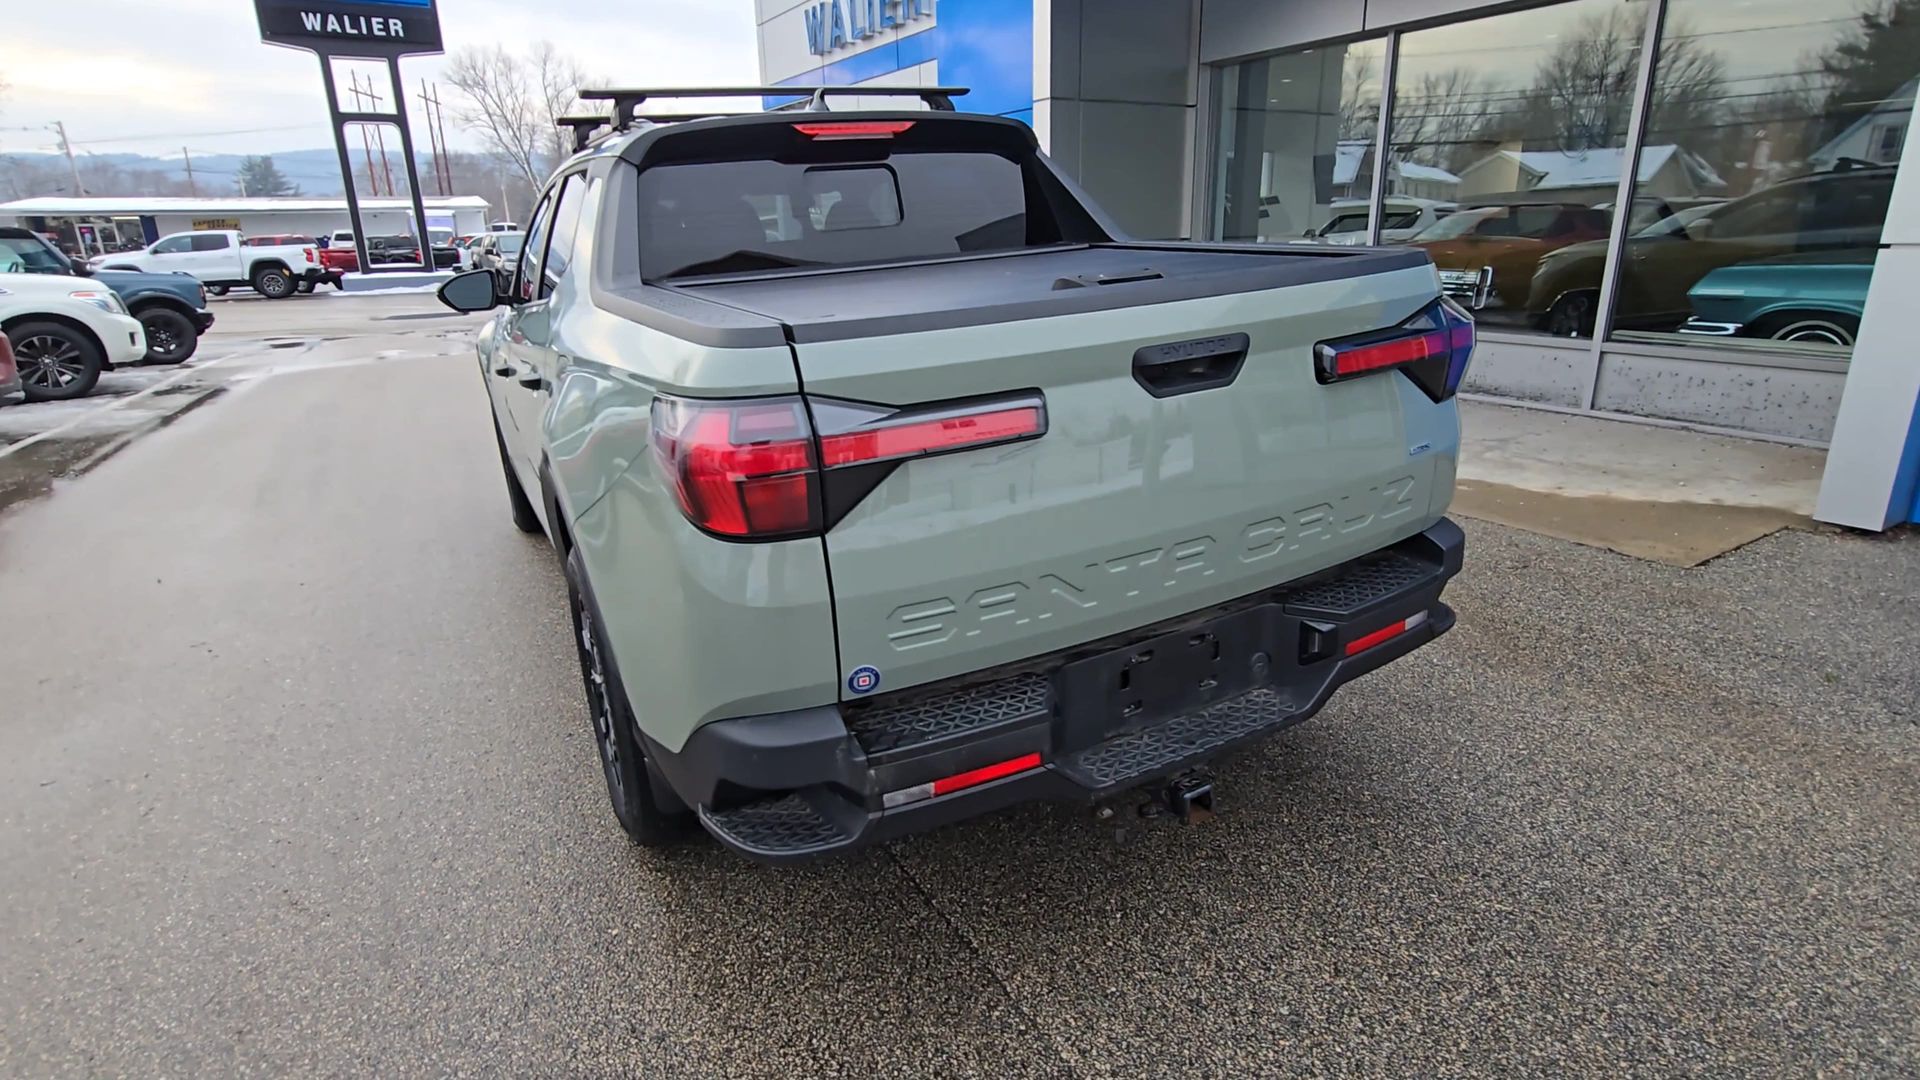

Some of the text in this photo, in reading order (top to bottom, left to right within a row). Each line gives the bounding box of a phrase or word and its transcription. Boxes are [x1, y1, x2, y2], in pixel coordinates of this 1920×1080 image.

[300, 11, 404, 37] WALIER
[886, 475, 1416, 650] SANTA CRUZ
